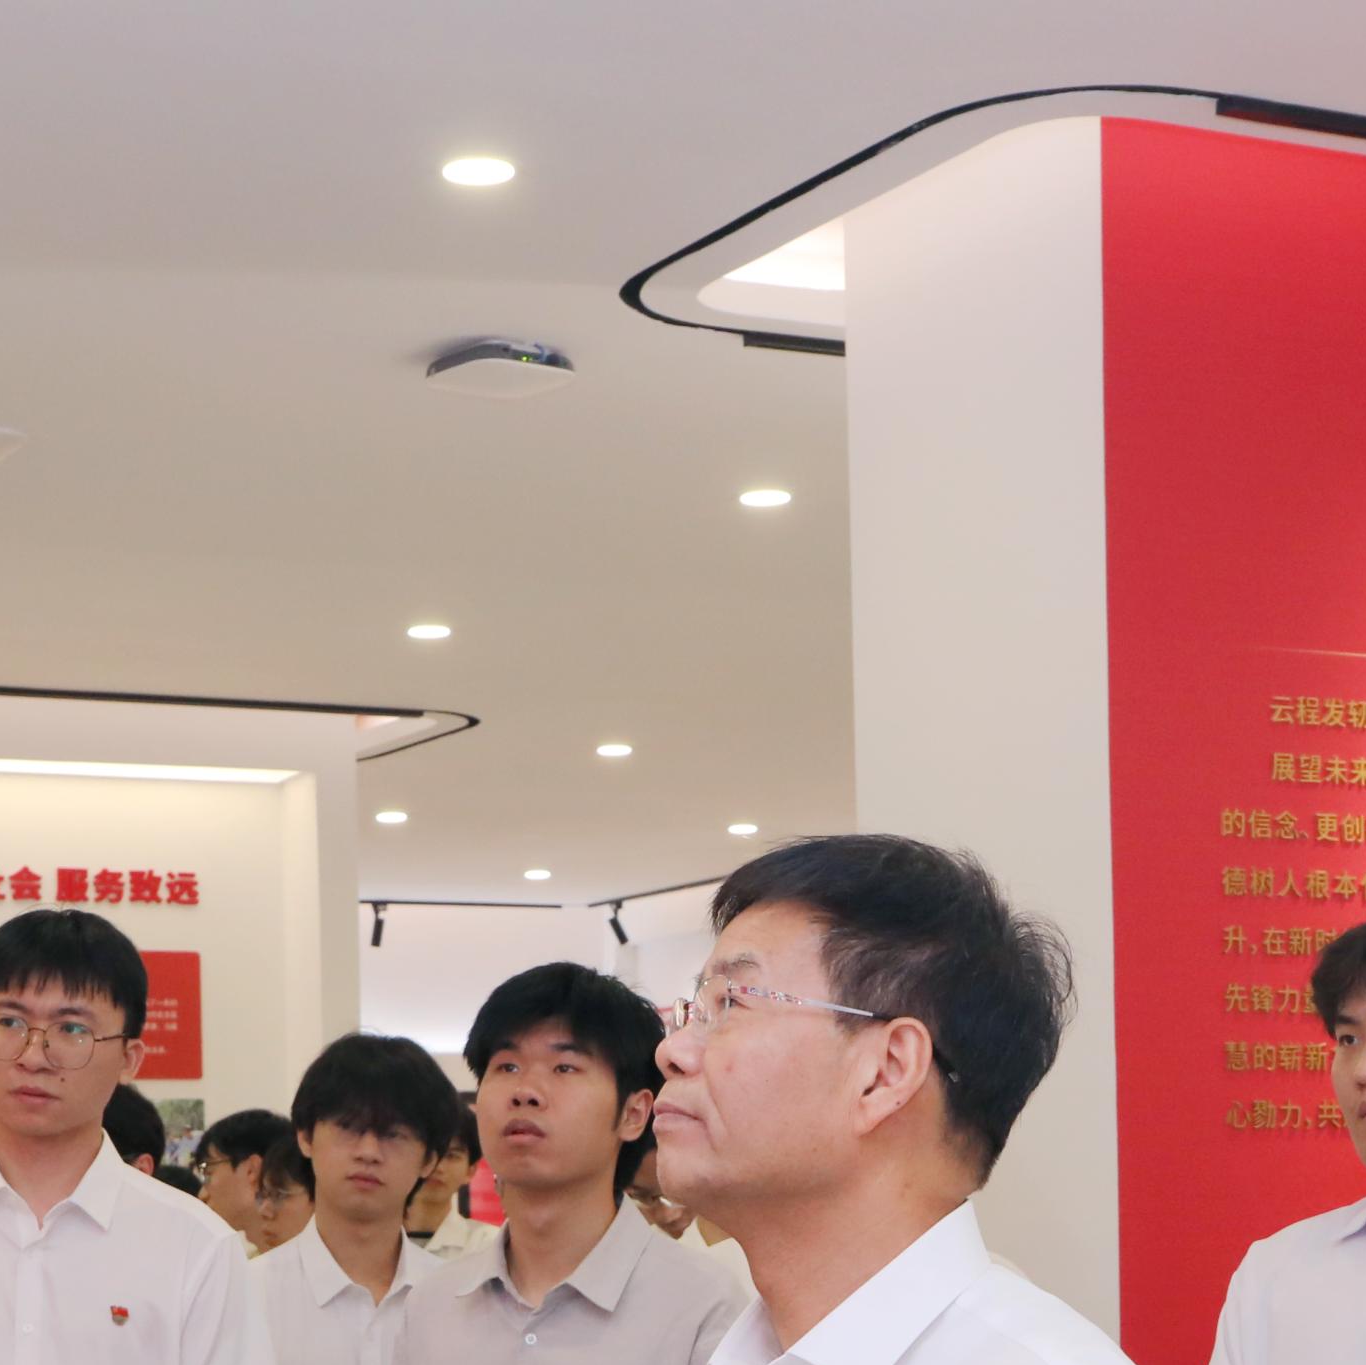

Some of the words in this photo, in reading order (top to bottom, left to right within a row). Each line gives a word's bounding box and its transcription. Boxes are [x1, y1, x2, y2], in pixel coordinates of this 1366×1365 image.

[56, 868, 200, 905] 服务致远
[1223, 925, 1348, 956] 升，在新时
[1225, 1041, 1336, 1072] 慧的崭新
[1226, 1099, 1350, 1129] 心勠力，共
